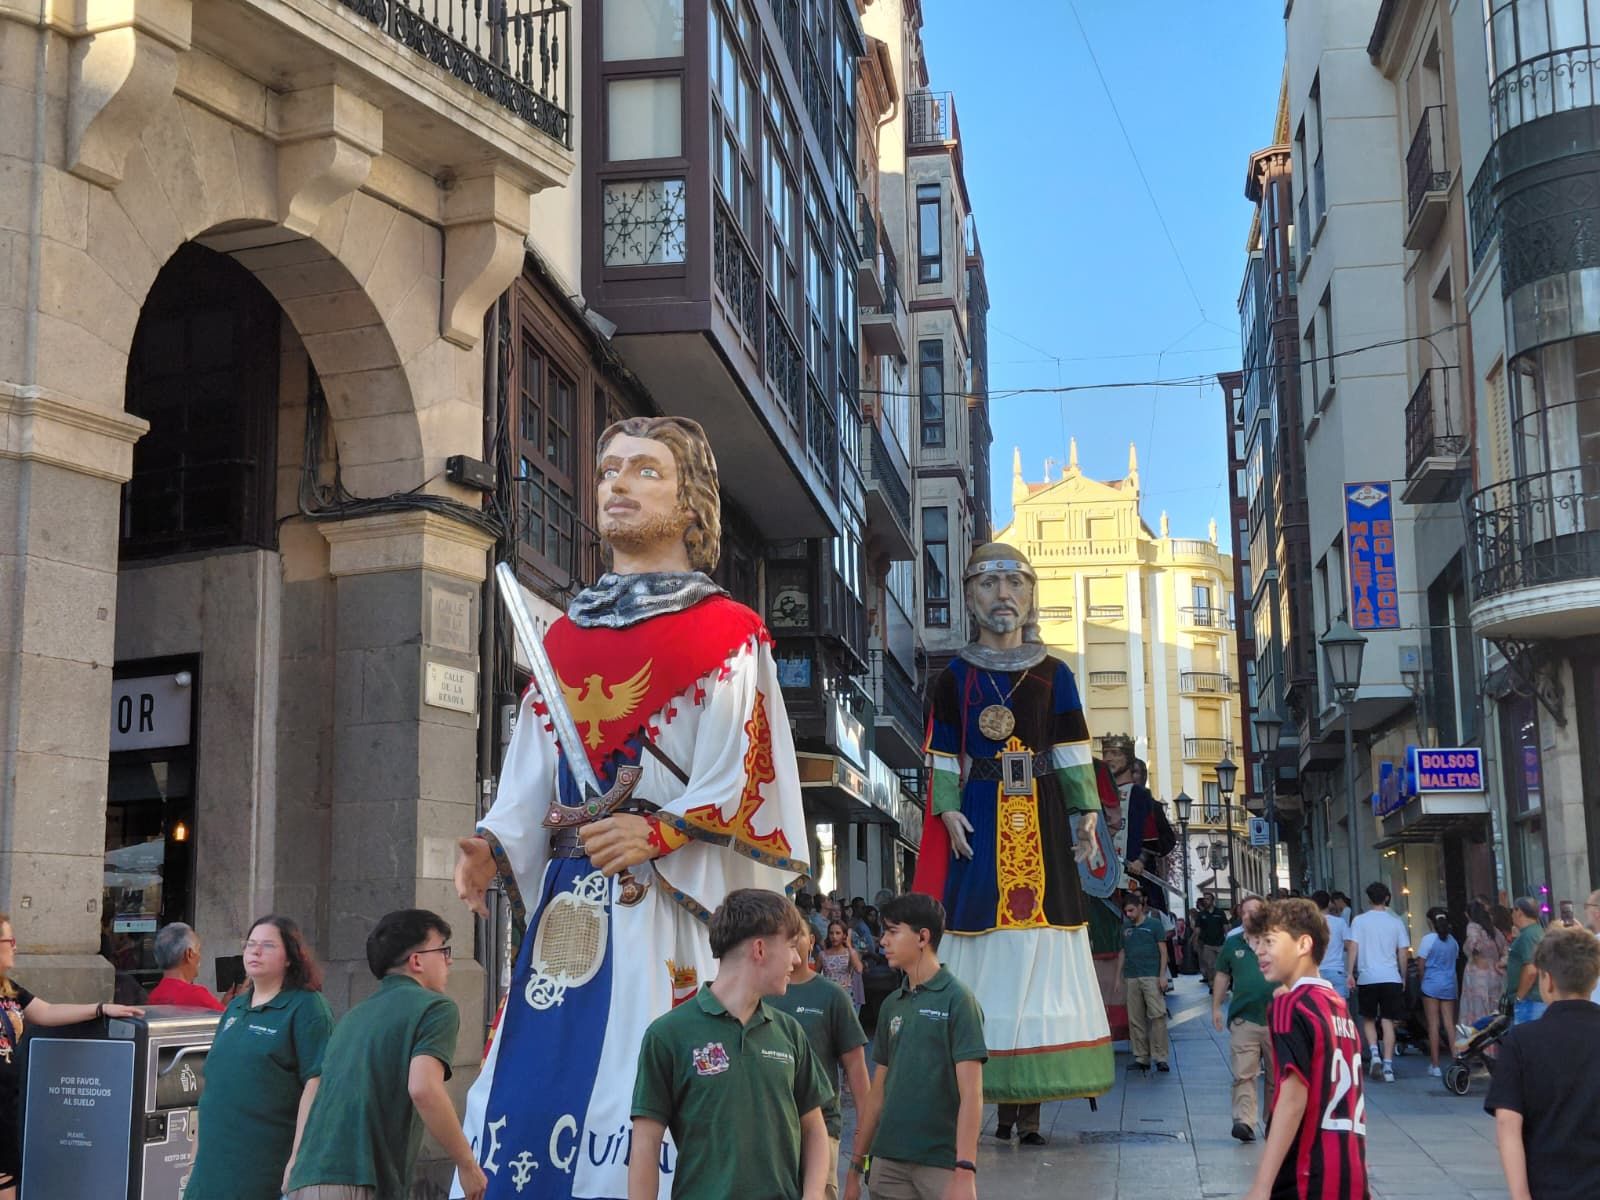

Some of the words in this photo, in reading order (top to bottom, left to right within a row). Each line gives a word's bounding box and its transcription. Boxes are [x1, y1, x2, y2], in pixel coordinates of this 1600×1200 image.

[1350, 520, 1375, 627] MALETAS
[1373, 519, 1398, 626] BOLSOS
[444, 671, 465, 684] CALLE
[1422, 754, 1476, 769] BOLSOS
[1420, 773, 1480, 787] MALETAS
[60, 1076, 76, 1085] POR
[77, 1077, 101, 1087] FAVOR,
[48, 1087, 60, 1095] NO
[61, 1087, 76, 1096] TIRE
[77, 1088, 112, 1097] RESIDUOS
[1321, 1048, 1367, 1135] 22
[63, 1098, 73, 1106] AL
[73, 1098, 96, 1107] SUELO
